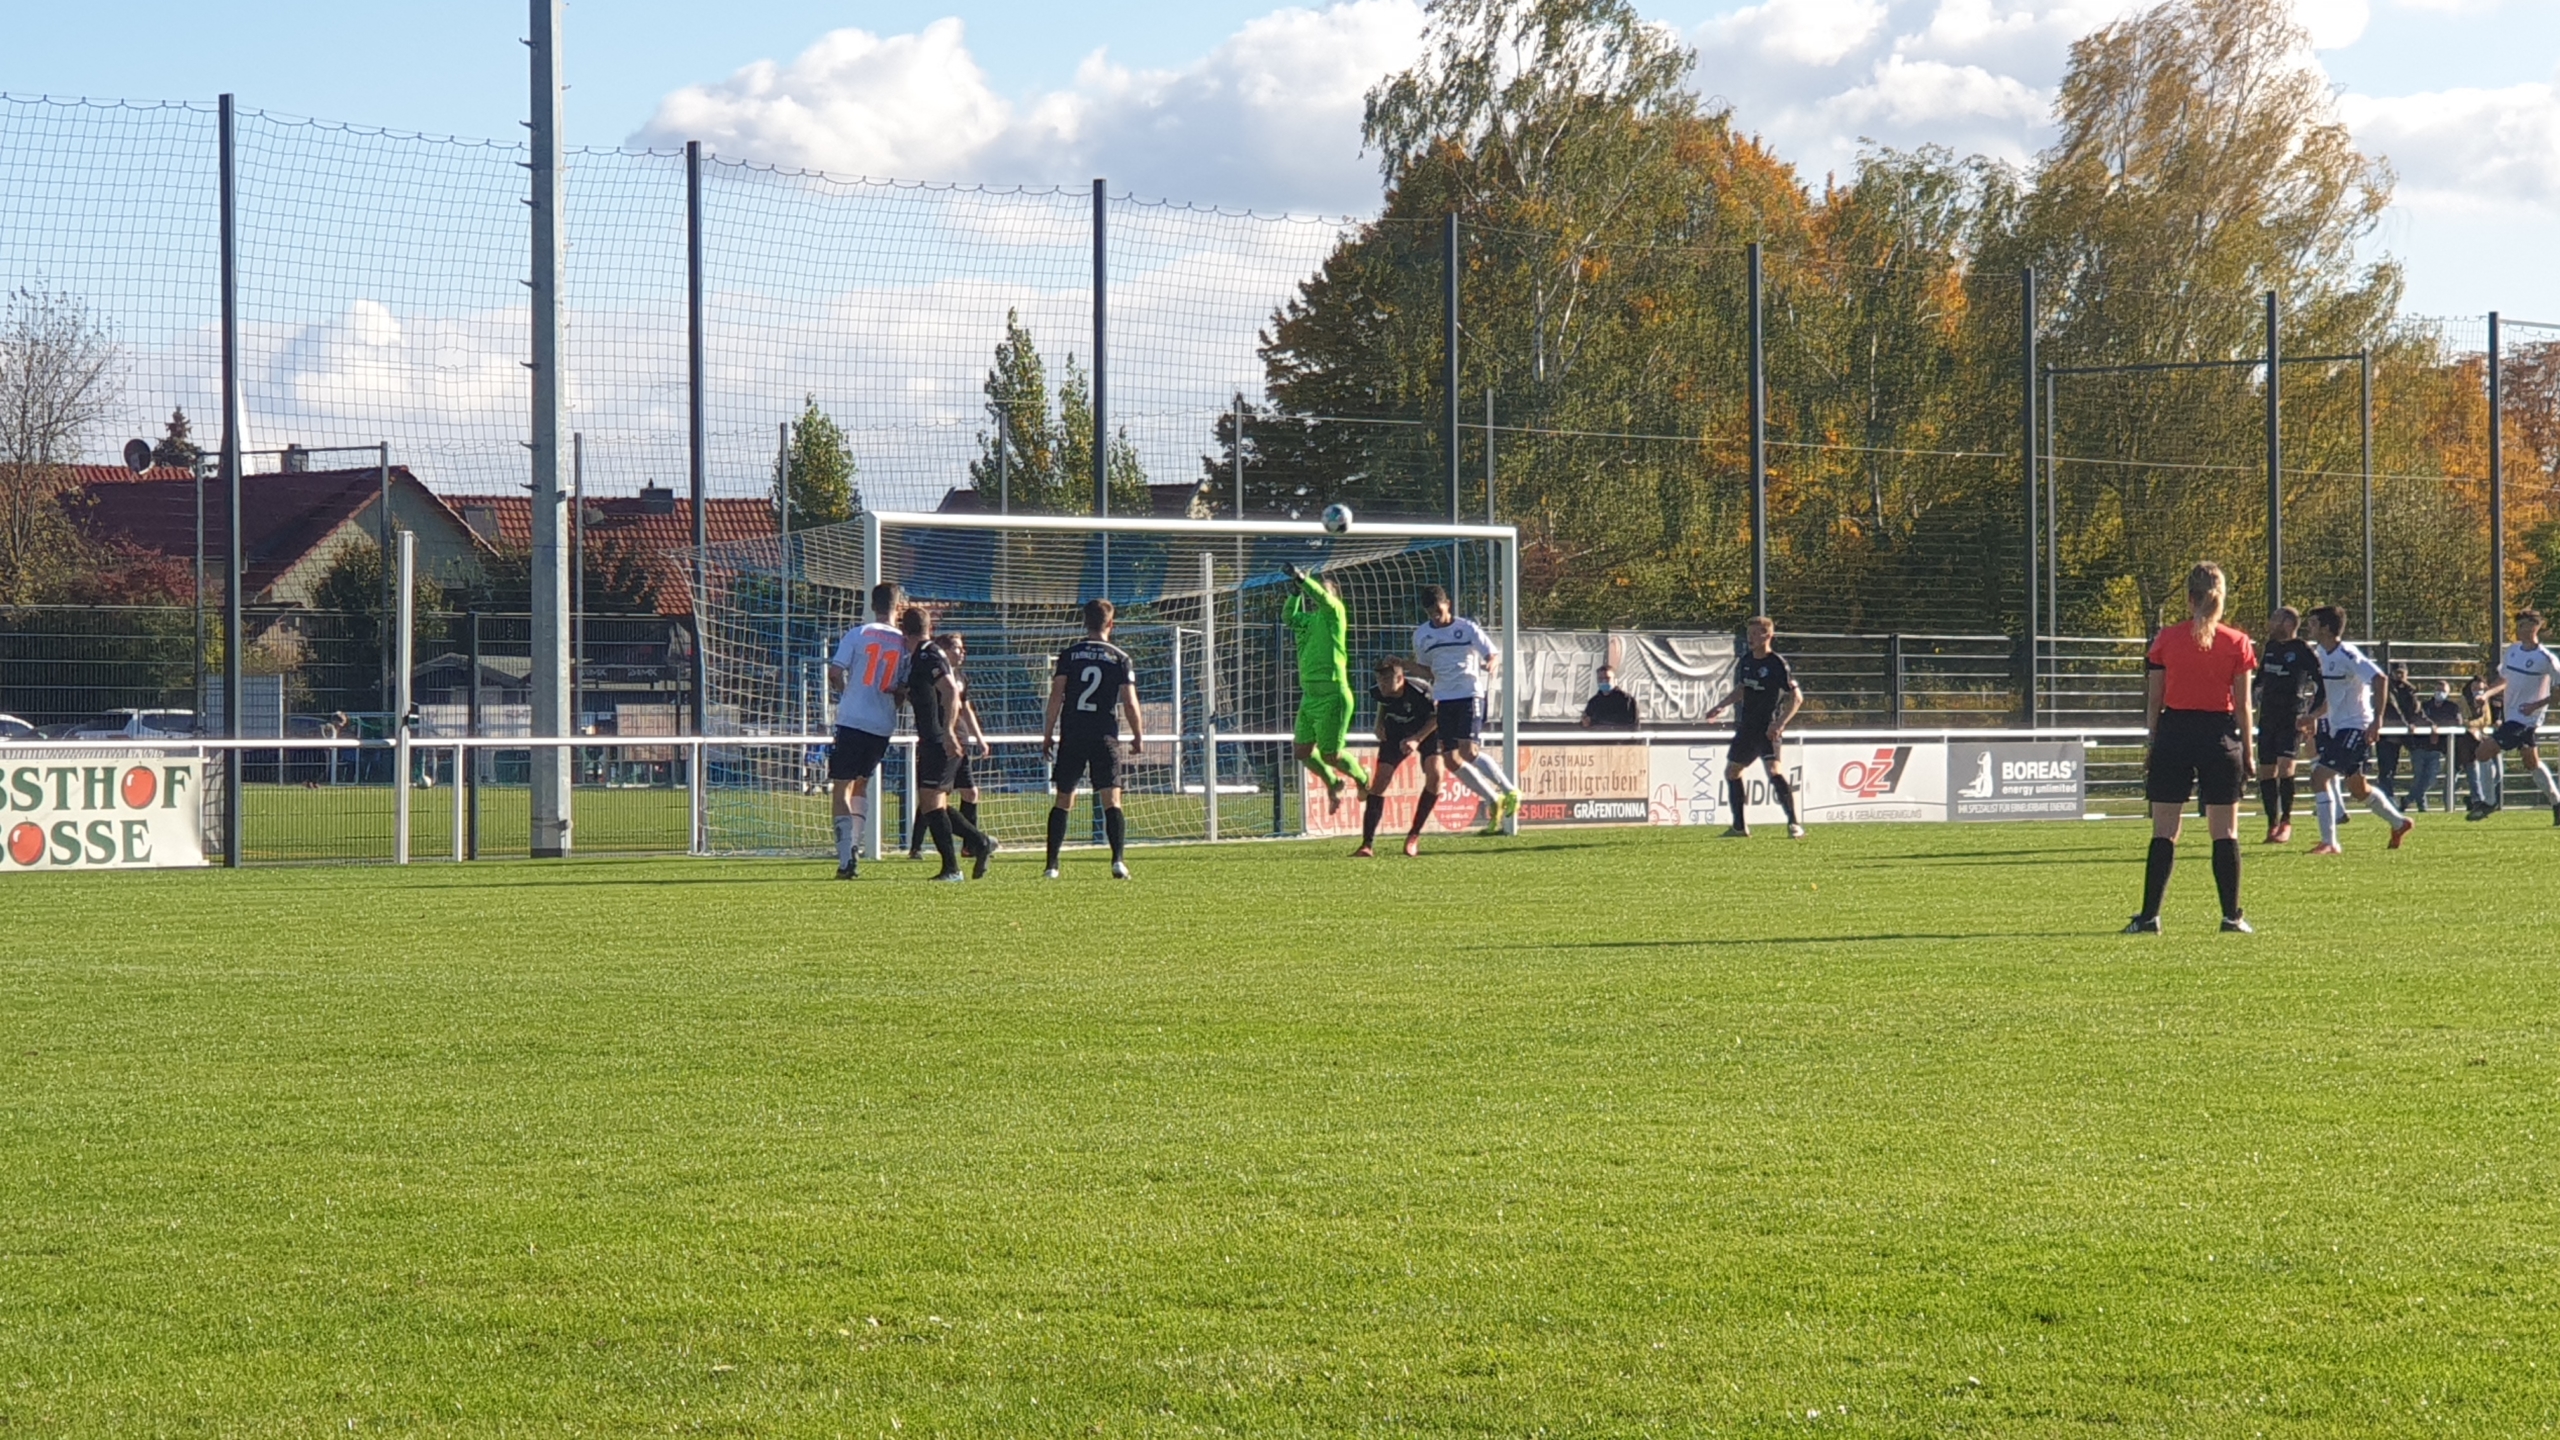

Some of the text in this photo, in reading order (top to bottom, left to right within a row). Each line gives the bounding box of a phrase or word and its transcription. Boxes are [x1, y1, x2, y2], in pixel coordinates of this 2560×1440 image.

[863, 642, 900, 693] 11
[1077, 666, 1102, 711] 2
[1539, 755, 1595, 768] GASTHAUS
[0, 765, 192, 812] STHOF
[1530, 803, 1567, 819] BUFFET
[1573, 801, 1647, 819] GRÄFENTONNA
[2002, 782, 2077, 796] energy unlimited
[0, 819, 153, 866] OSSE
